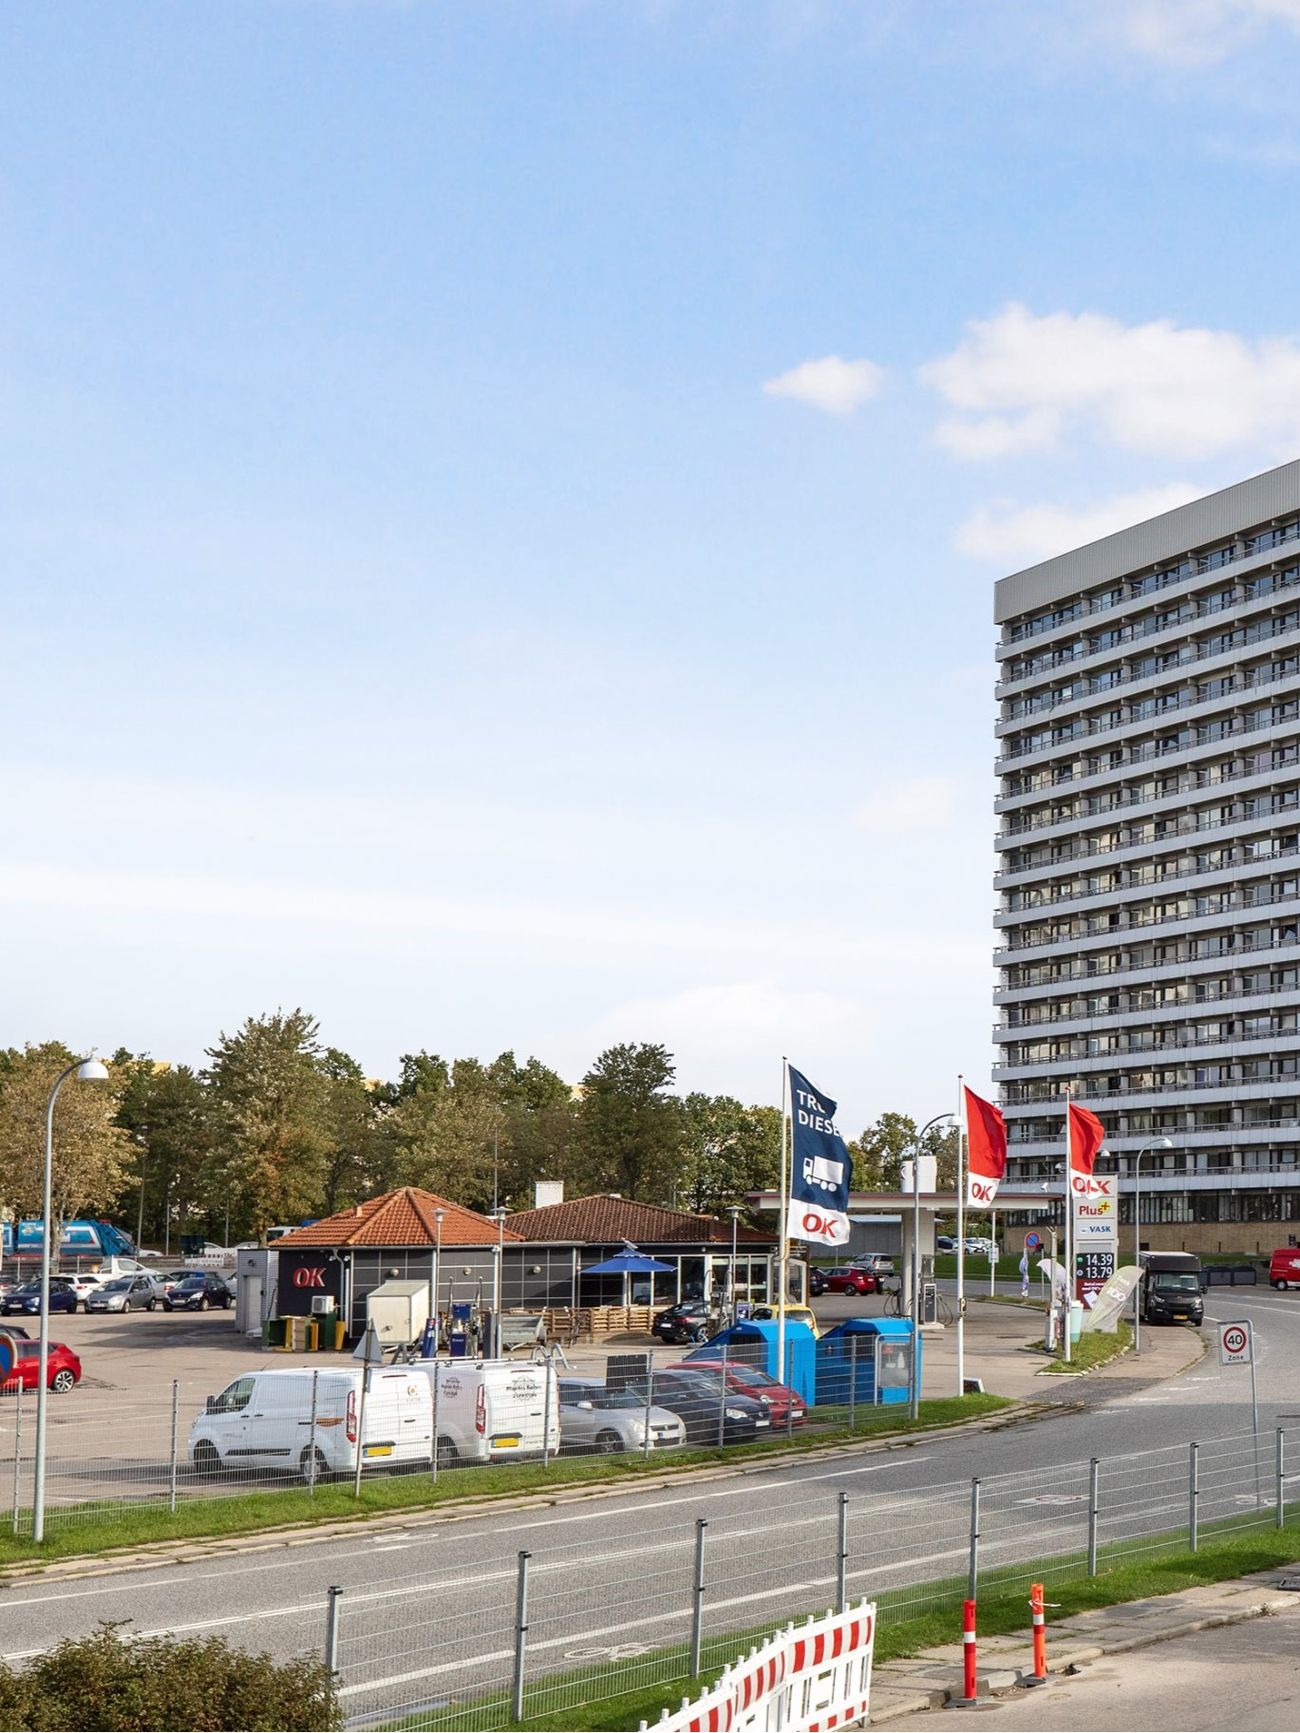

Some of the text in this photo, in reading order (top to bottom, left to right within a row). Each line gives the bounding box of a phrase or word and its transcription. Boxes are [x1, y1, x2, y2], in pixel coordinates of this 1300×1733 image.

[971, 1183, 992, 1201] OK
[802, 1213, 839, 1238] OK
[1086, 1254, 1113, 1266] 14.39
[293, 1267, 327, 1287] OK
[1086, 1267, 1113, 1278] 13.79
[1228, 1334, 1243, 1345] 40
